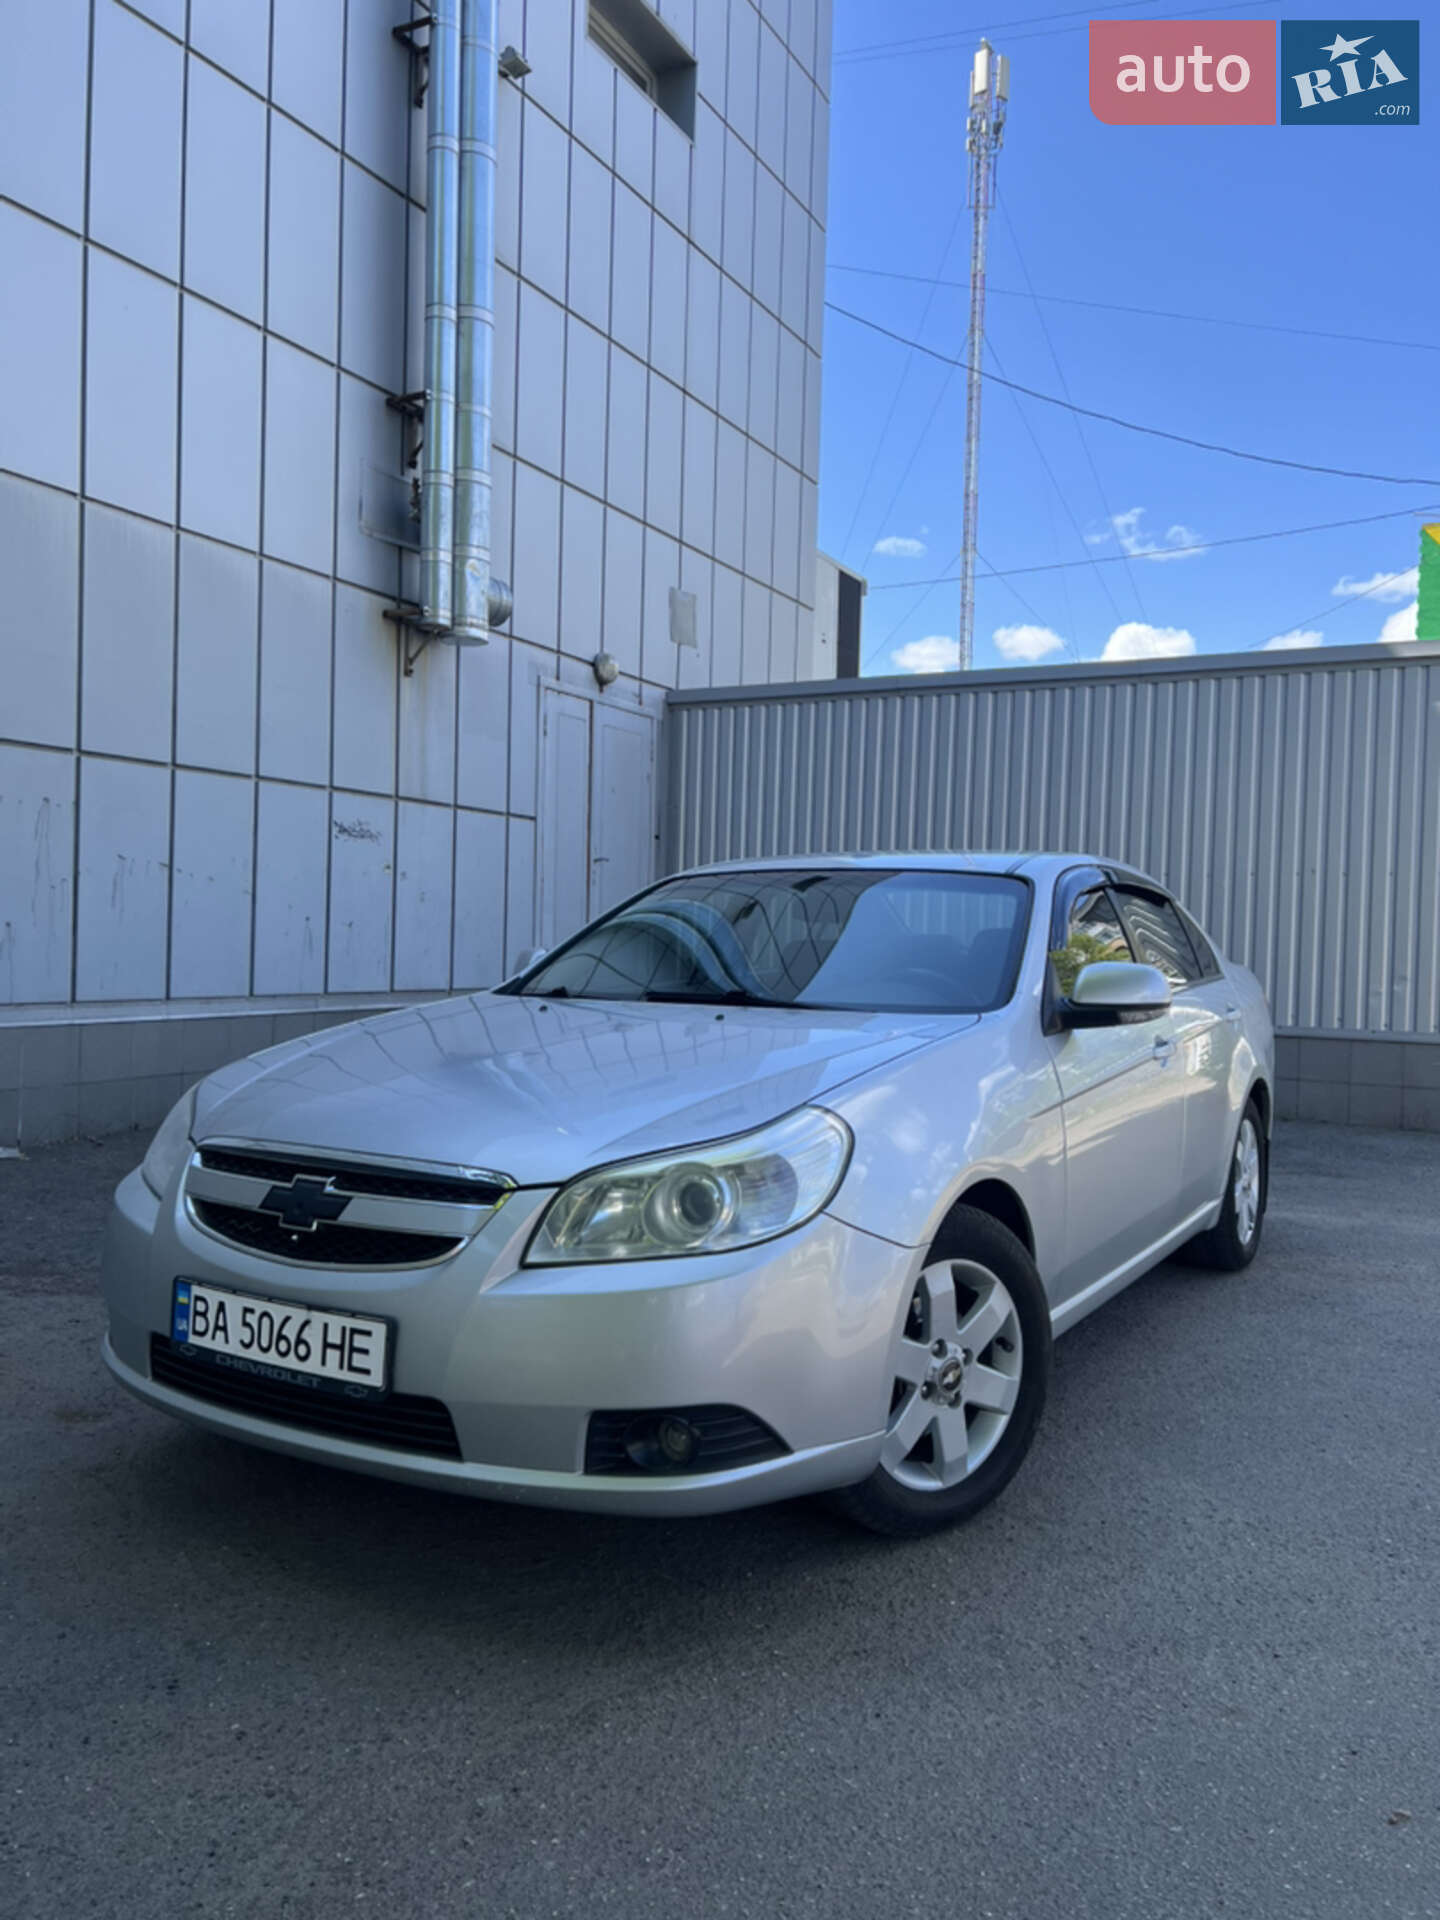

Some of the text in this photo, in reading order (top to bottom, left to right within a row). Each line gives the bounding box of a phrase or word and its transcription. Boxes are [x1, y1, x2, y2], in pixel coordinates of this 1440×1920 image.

[191, 1295, 373, 1376] BA 5066 HE
[215, 1353, 322, 1388] CHEVROLET
